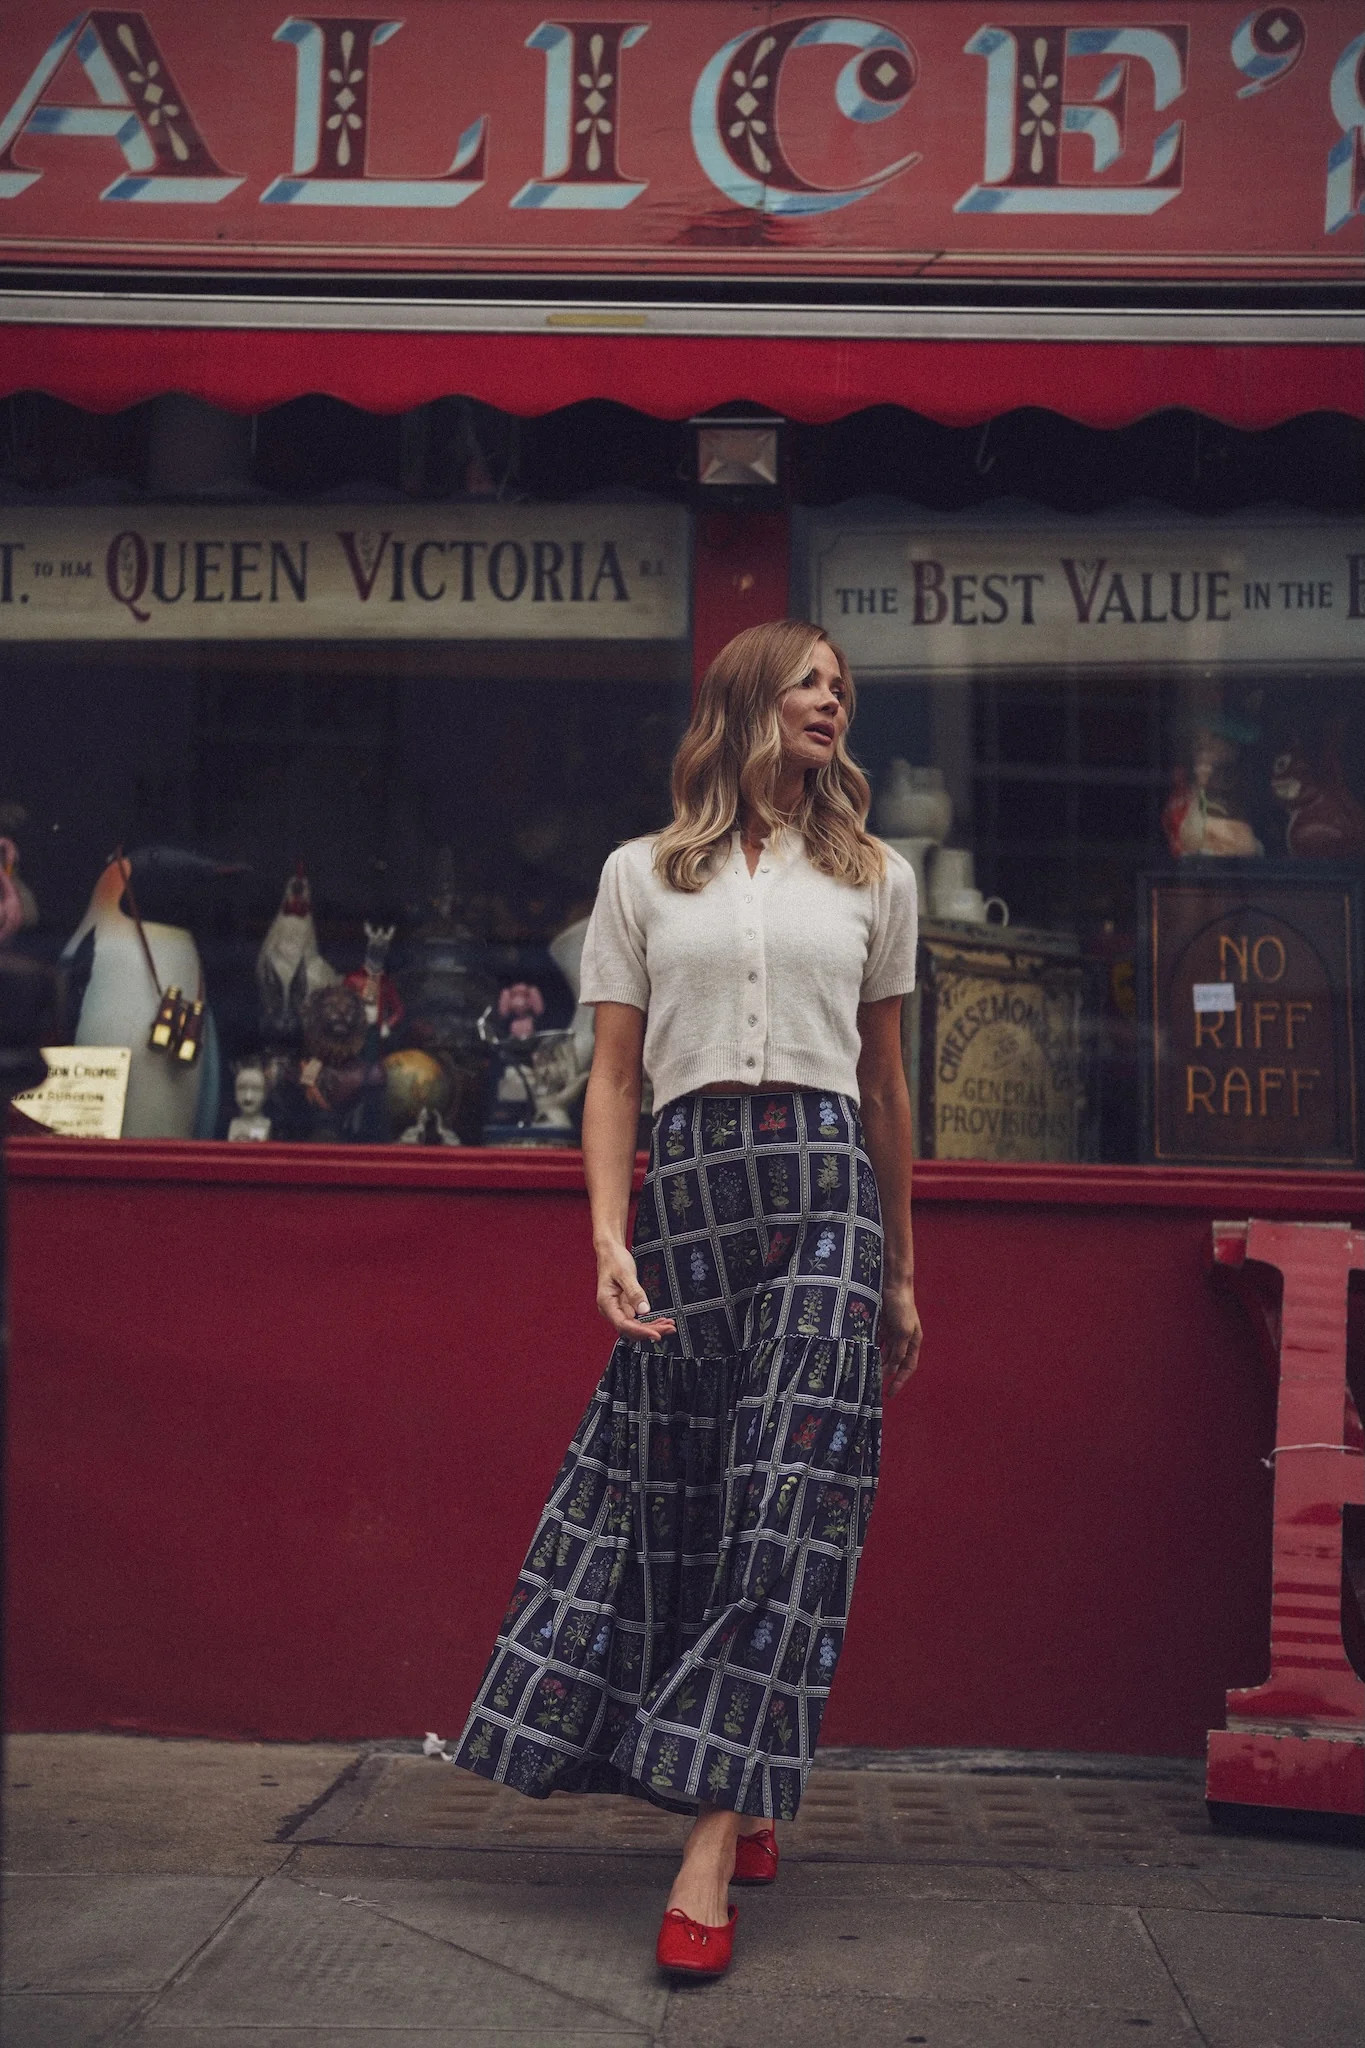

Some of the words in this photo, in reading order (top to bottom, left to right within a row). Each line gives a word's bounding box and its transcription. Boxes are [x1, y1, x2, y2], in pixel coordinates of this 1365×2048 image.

[0, 5, 1365, 233] ALICE'
[106, 531, 309, 622] QUEEN
[336, 530, 631, 602] VICTORIA
[836, 588, 897, 614] THE
[911, 559, 1044, 625] BEST
[1060, 558, 1231, 623] VALUE
[1244, 582, 1270, 610] IN
[1278, 581, 1333, 609] THE
[1219, 935, 1285, 983] NO
[1195, 1002, 1312, 1049] RIFF
[1186, 1065, 1320, 1116] RAFF
